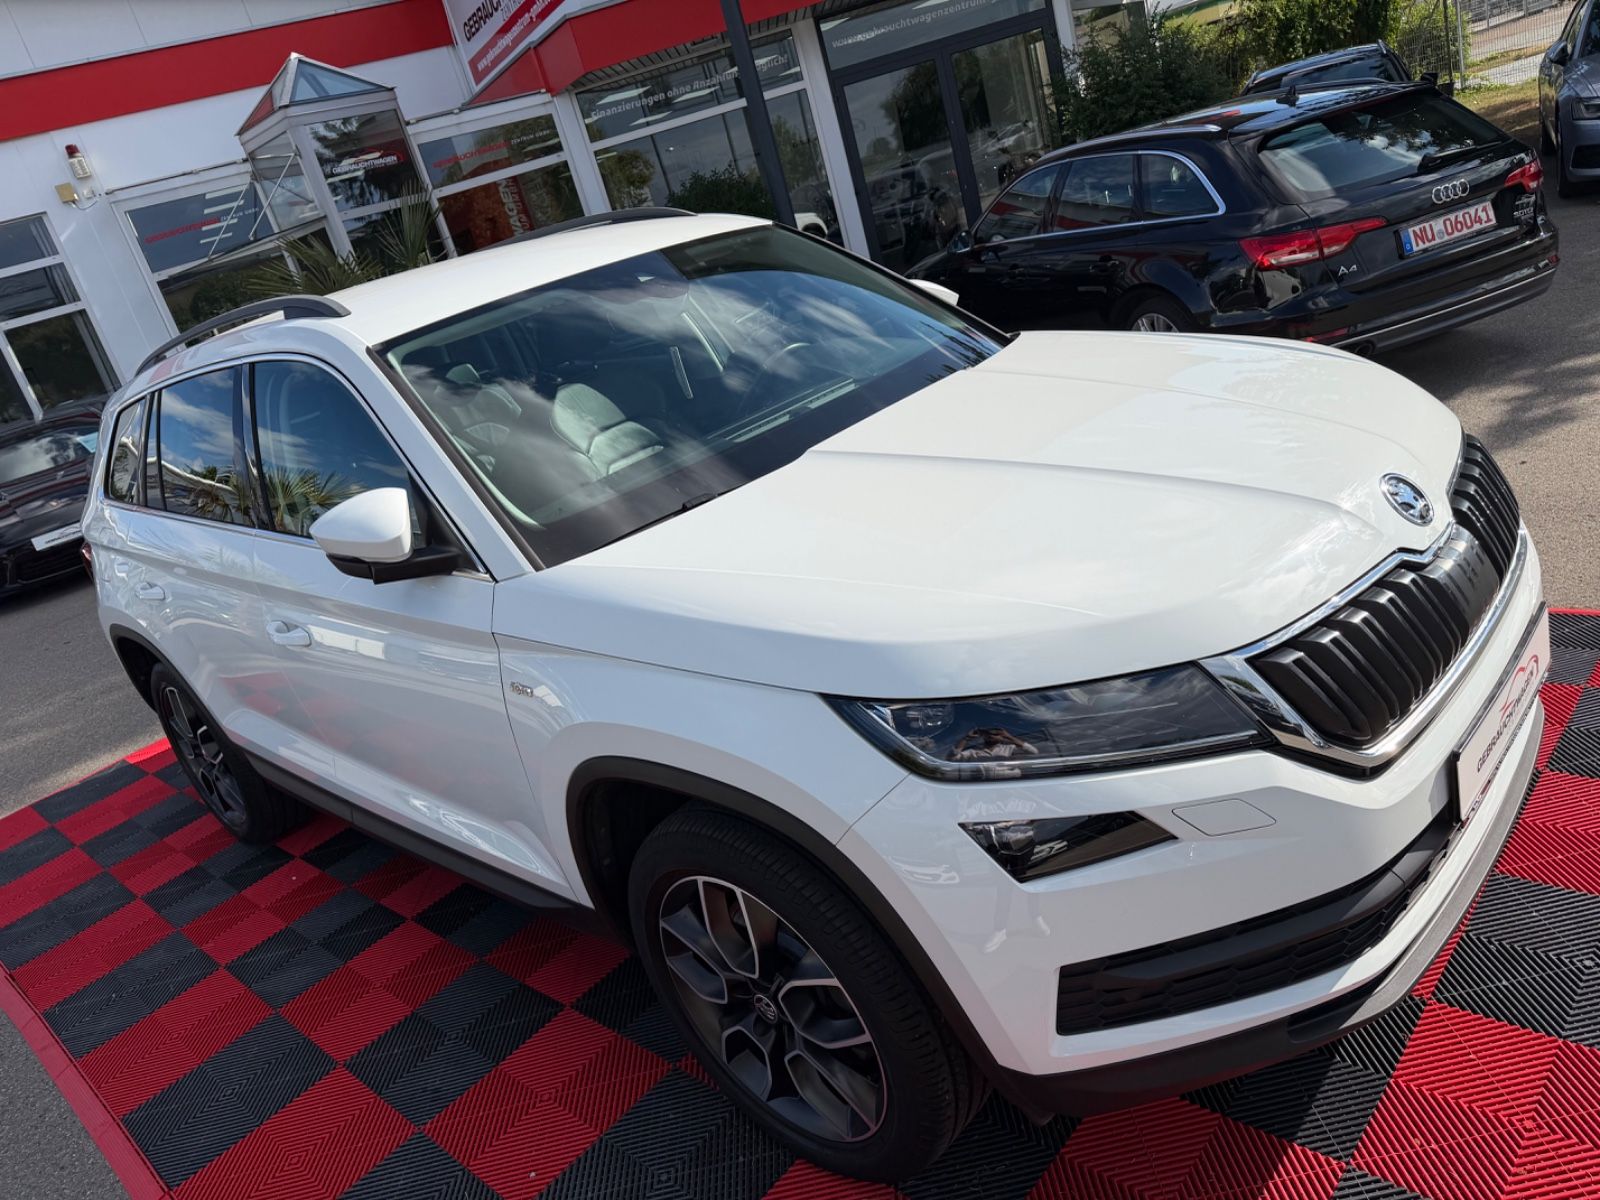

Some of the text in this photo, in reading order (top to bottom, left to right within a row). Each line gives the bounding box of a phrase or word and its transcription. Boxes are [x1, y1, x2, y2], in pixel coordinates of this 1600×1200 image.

[590, 91, 666, 119] Finanzierungen
[667, 82, 691, 99] ohne
[692, 70, 738, 91] Anzahlun
[1412, 223, 1436, 248] NU
[1442, 204, 1494, 237] 06041
[1338, 264, 1358, 277] A4
